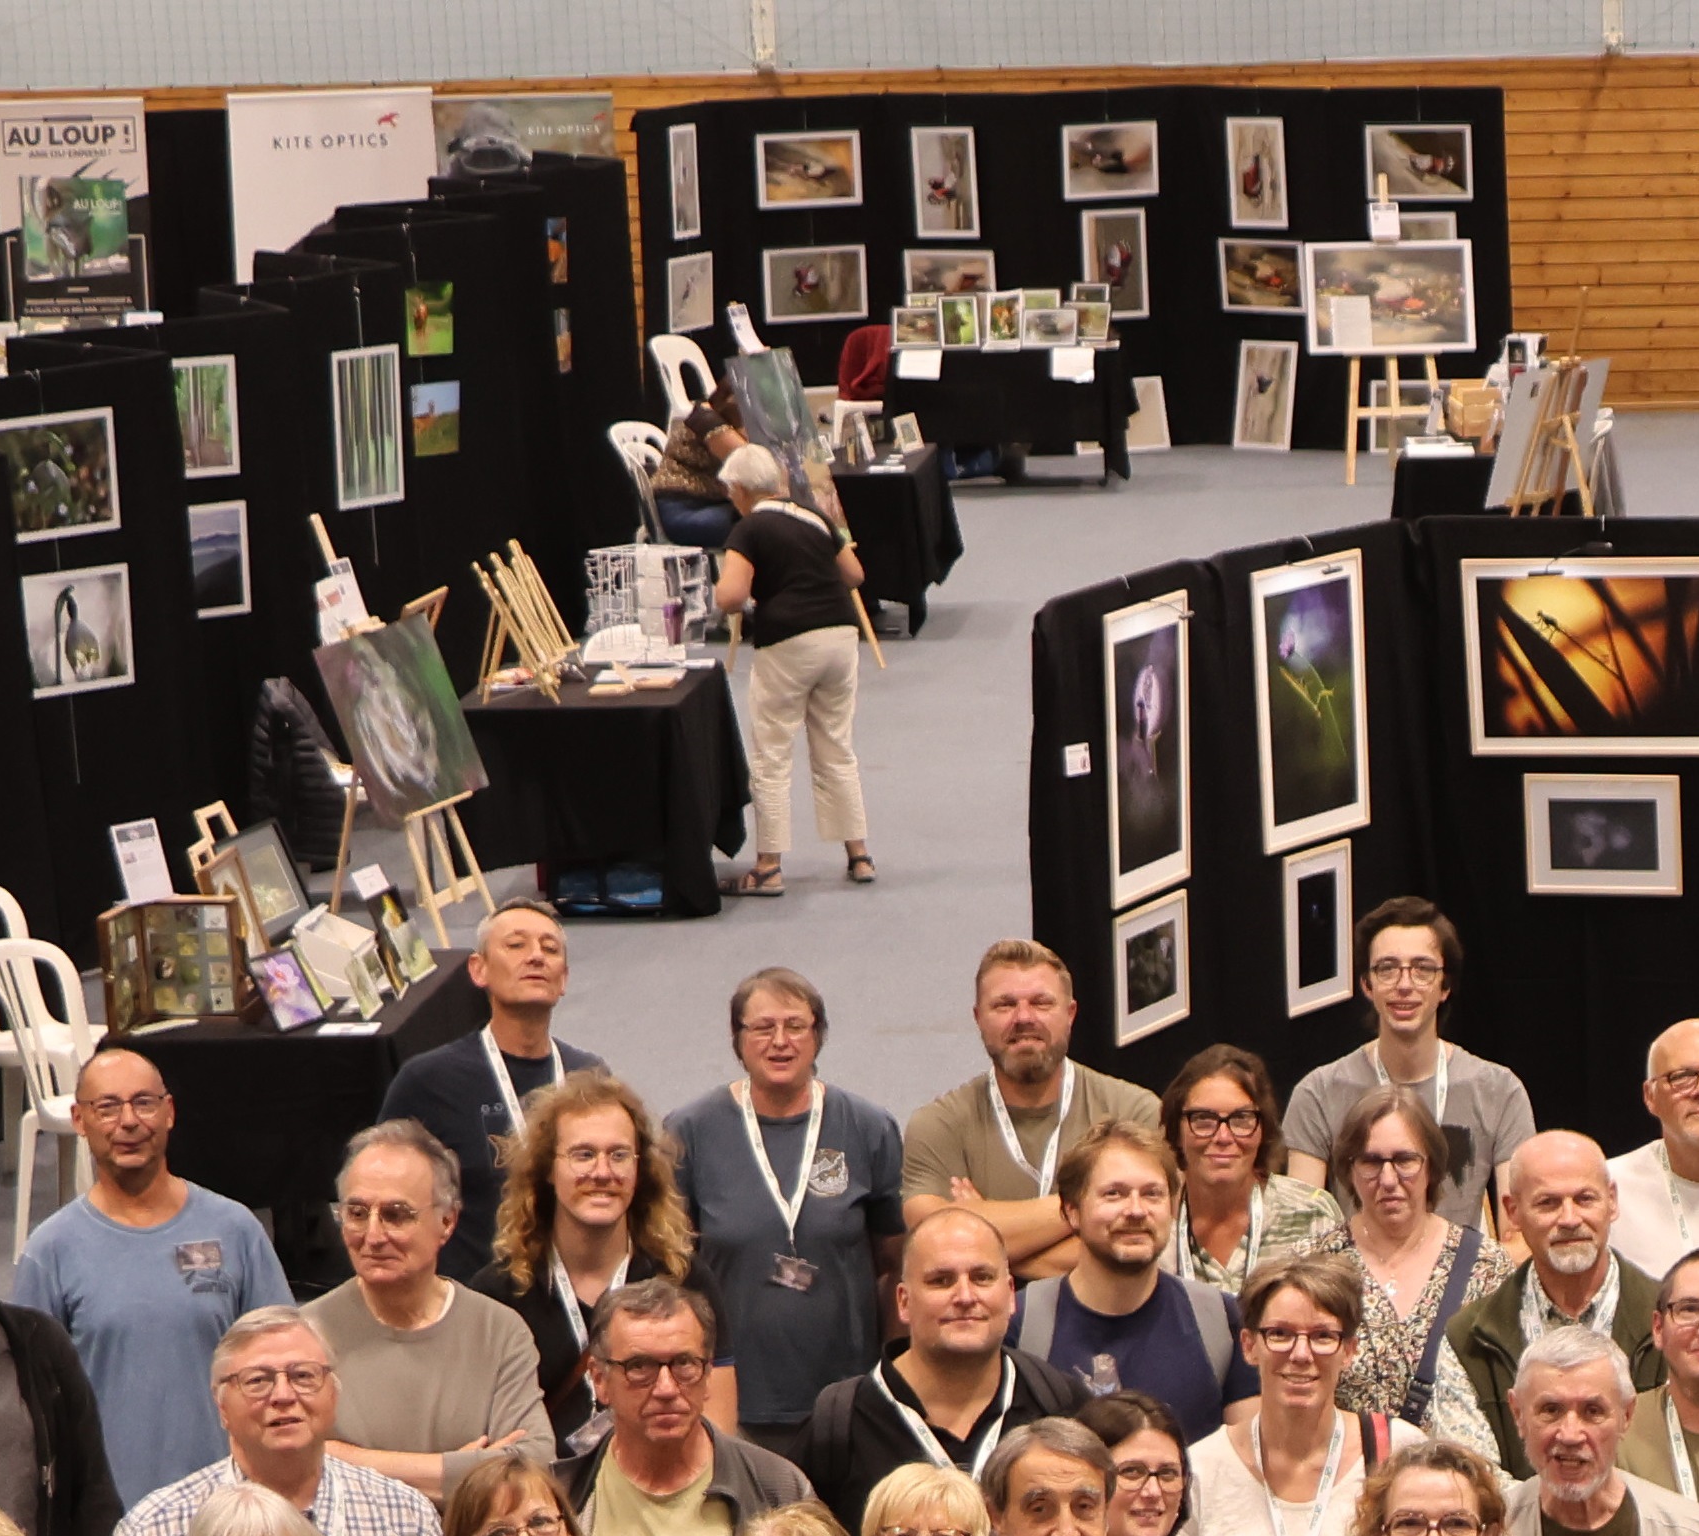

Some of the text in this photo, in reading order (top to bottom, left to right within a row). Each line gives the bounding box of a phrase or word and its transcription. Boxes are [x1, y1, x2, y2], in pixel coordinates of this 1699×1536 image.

[8, 126, 41, 146] AU
[49, 125, 116, 146] LOUP
[273, 133, 389, 150] KITE OPTICS
